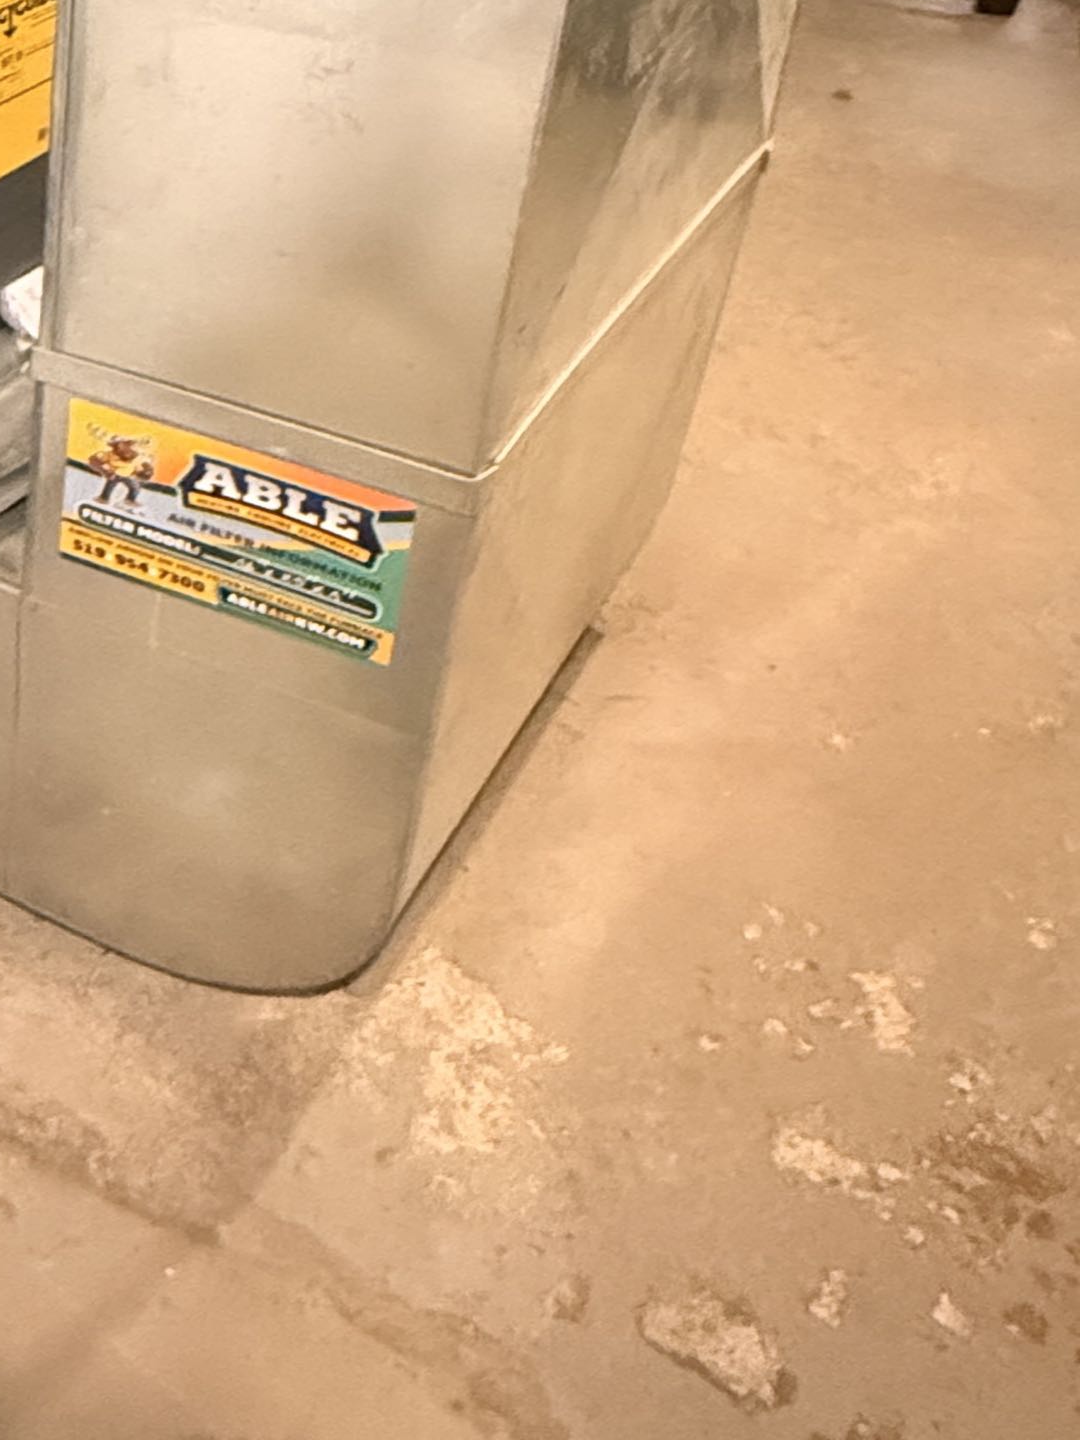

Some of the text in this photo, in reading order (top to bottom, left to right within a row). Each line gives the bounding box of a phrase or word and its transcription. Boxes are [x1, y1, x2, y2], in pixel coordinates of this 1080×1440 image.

[81, 506, 134, 534] FILTER
[193, 458, 362, 542] ABLE
[73, 538, 106, 559] 519
[114, 552, 148, 574] 954
[167, 511, 382, 592] AIR FILTER INFORMATION
